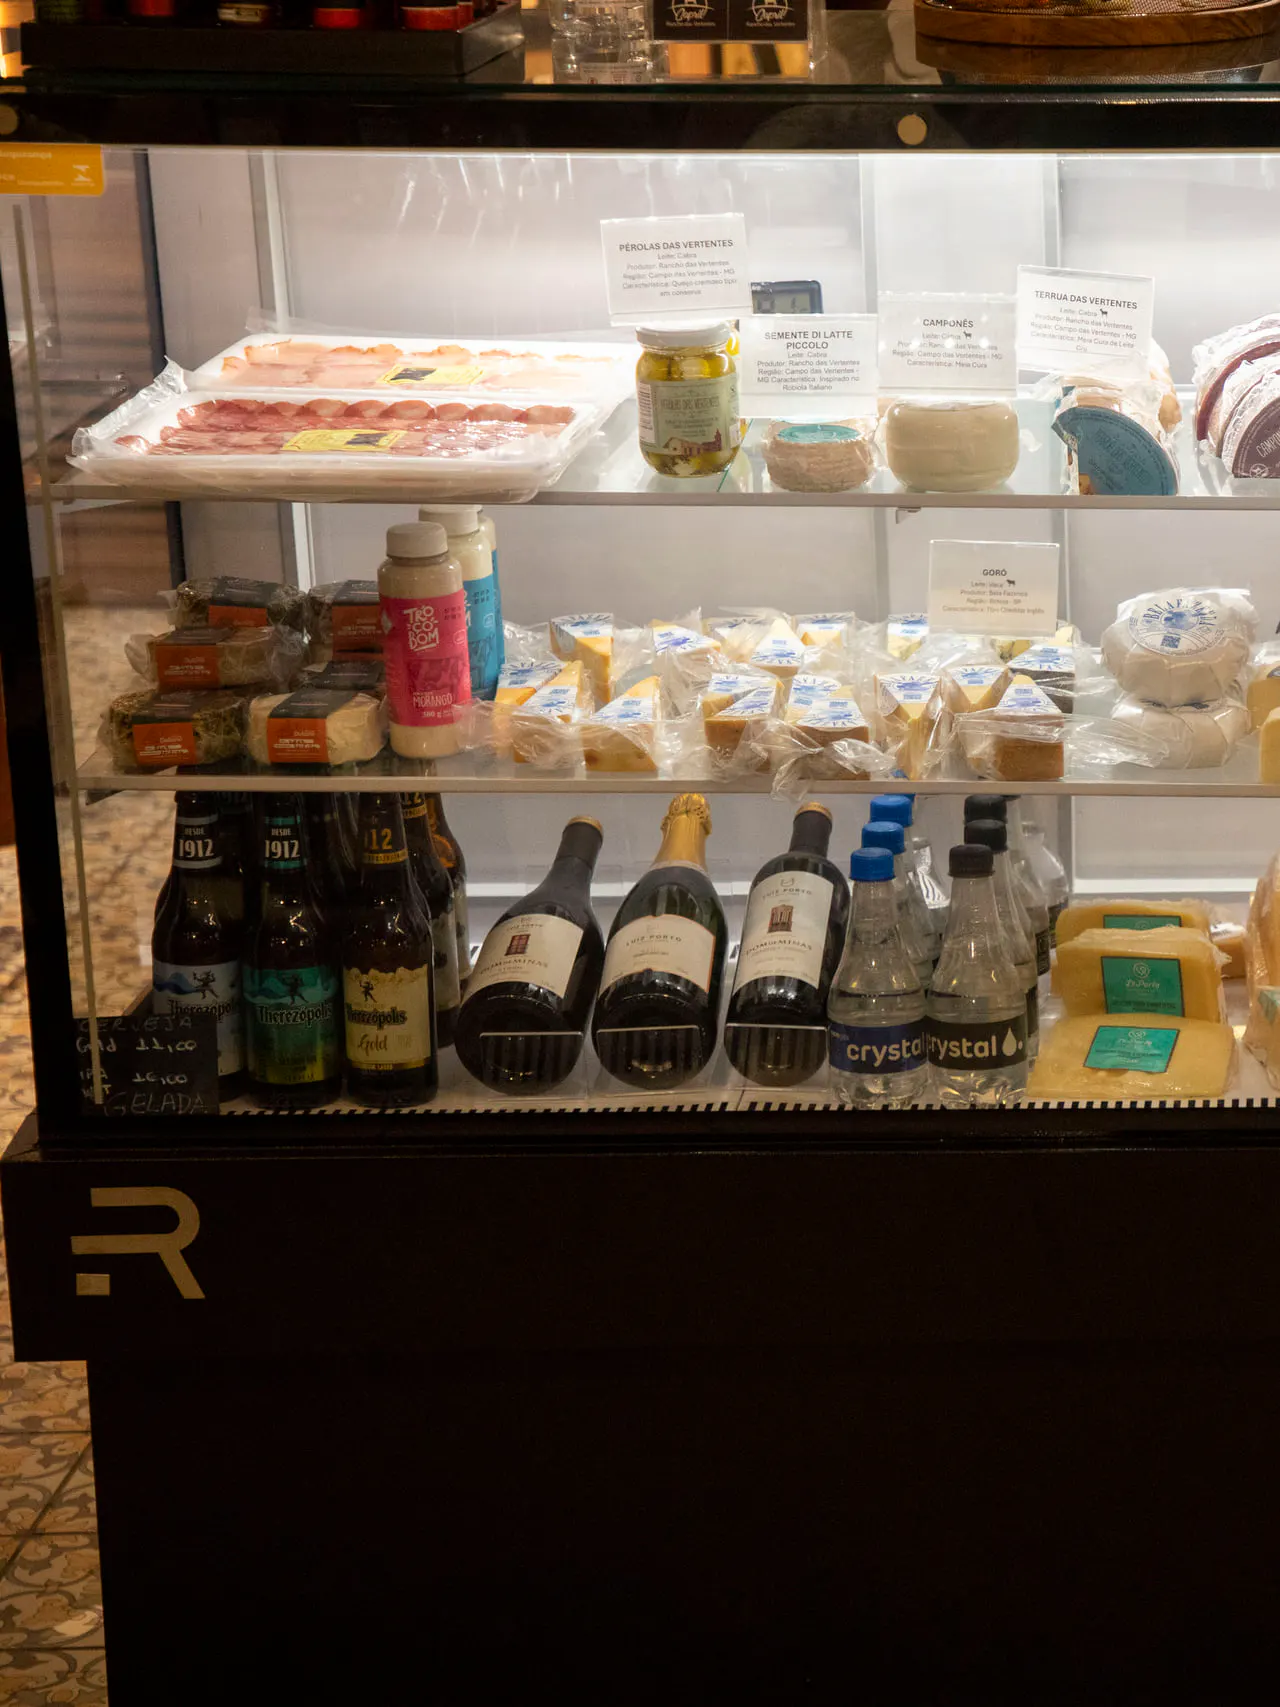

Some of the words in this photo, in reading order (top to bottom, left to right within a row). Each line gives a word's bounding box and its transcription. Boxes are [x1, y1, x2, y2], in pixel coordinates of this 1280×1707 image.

[619, 242, 660, 252] PÉROLAS
[663, 241, 680, 250] DAS
[682, 239, 733, 249] VERTENTES
[1035, 290, 1068, 302] TERRUA
[1070, 294, 1088, 304] DAS
[1089, 297, 1138, 310] VERTENTES
[923, 318, 974, 328] CAMPONÊS
[764, 331, 809, 340] SEMENTE
[812, 331, 821, 339] DI
[823, 330, 853, 339] LATTE
[786, 341, 829, 350] PICCOLO
[408, 628, 440, 650] BOM
[413, 692, 453, 707] MORANGO
[179, 839, 215, 859] 1912
[264, 839, 300, 859] 1912
[358, 1035, 388, 1054] Gold
[847, 1032, 925, 1068] crystal
